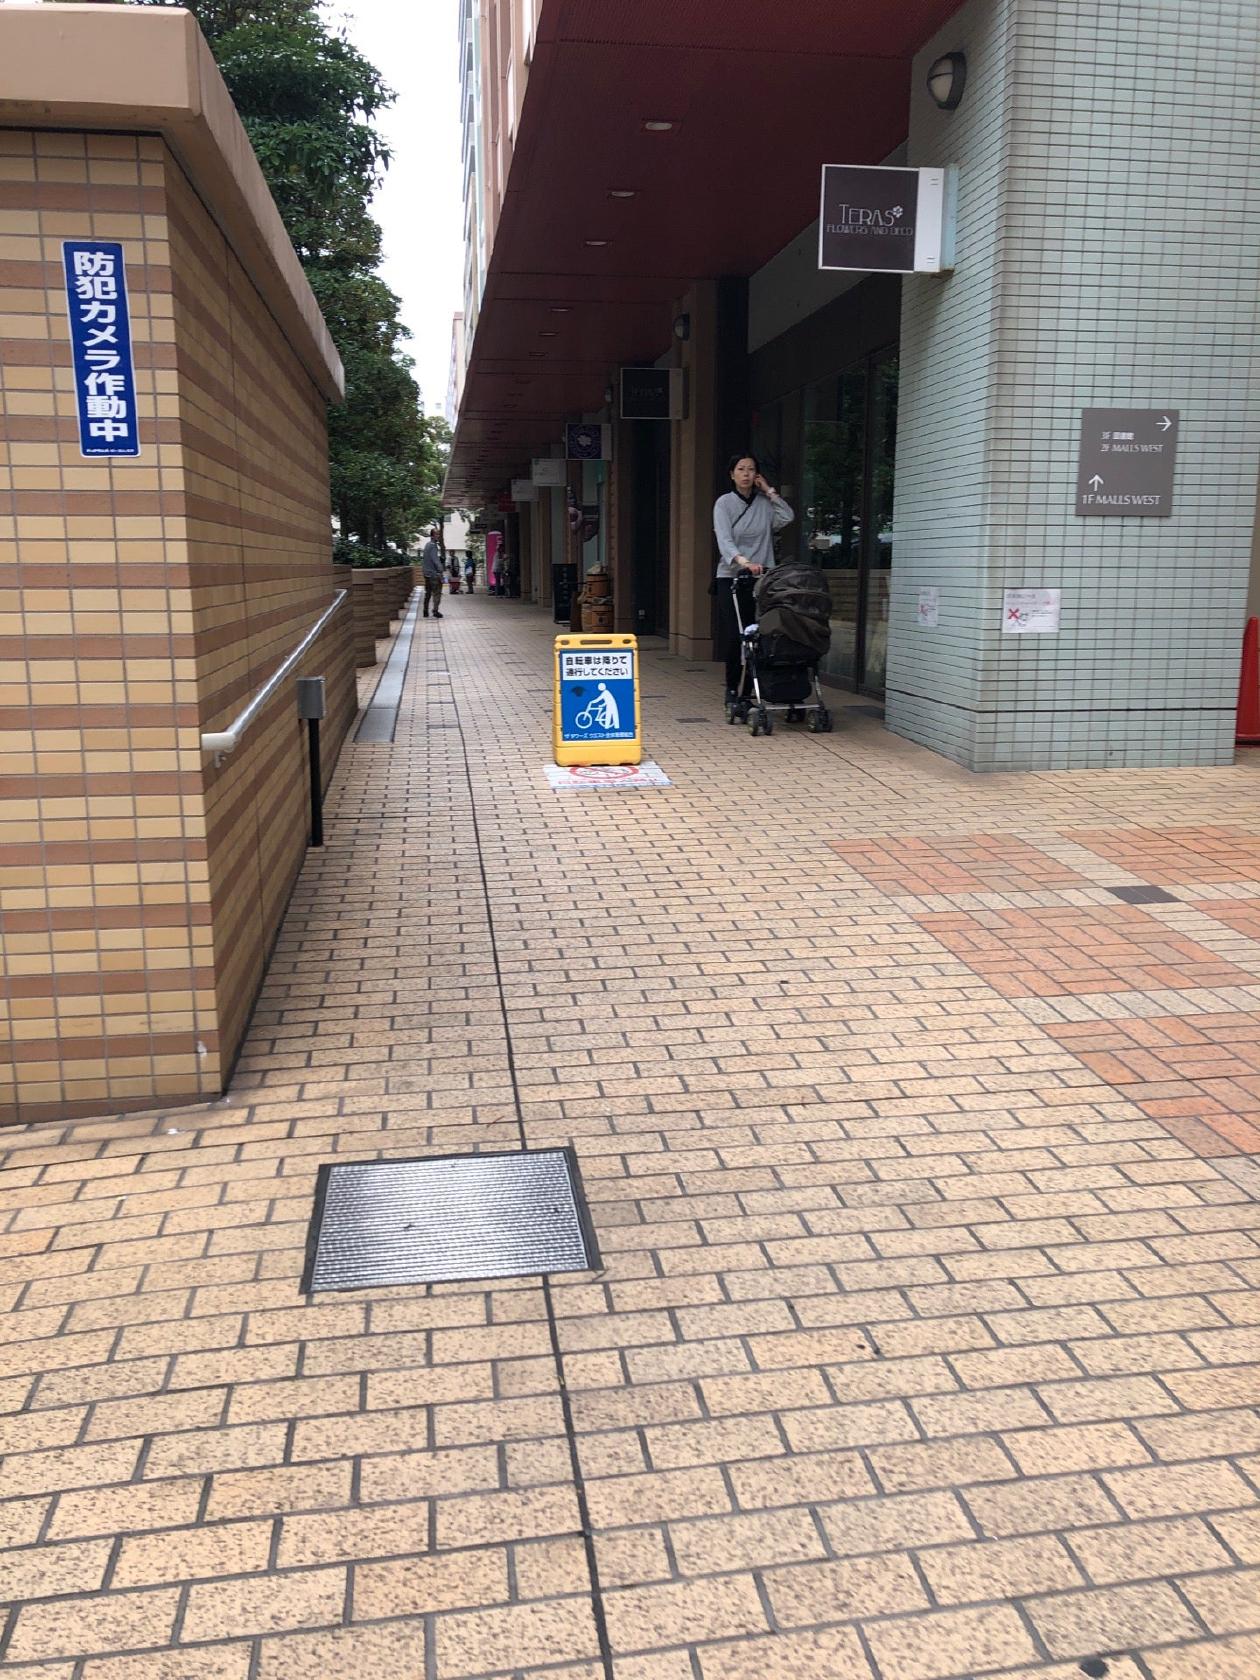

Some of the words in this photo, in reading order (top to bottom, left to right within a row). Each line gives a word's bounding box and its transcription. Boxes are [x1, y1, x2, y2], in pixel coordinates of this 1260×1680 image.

[839, 203, 895, 226] TERAS
[73, 250, 129, 442] 防犯カメラ作動中
[1112, 443, 1140, 453] MALLS
[1140, 443, 1164, 453] WEST
[1082, 494, 1095, 505] 1F
[1096, 494, 1131, 505] MALLS
[1131, 494, 1161, 505] WEST
[565, 655, 628, 666] 自転車は降りて
[566, 667, 629, 677] 通行してください
